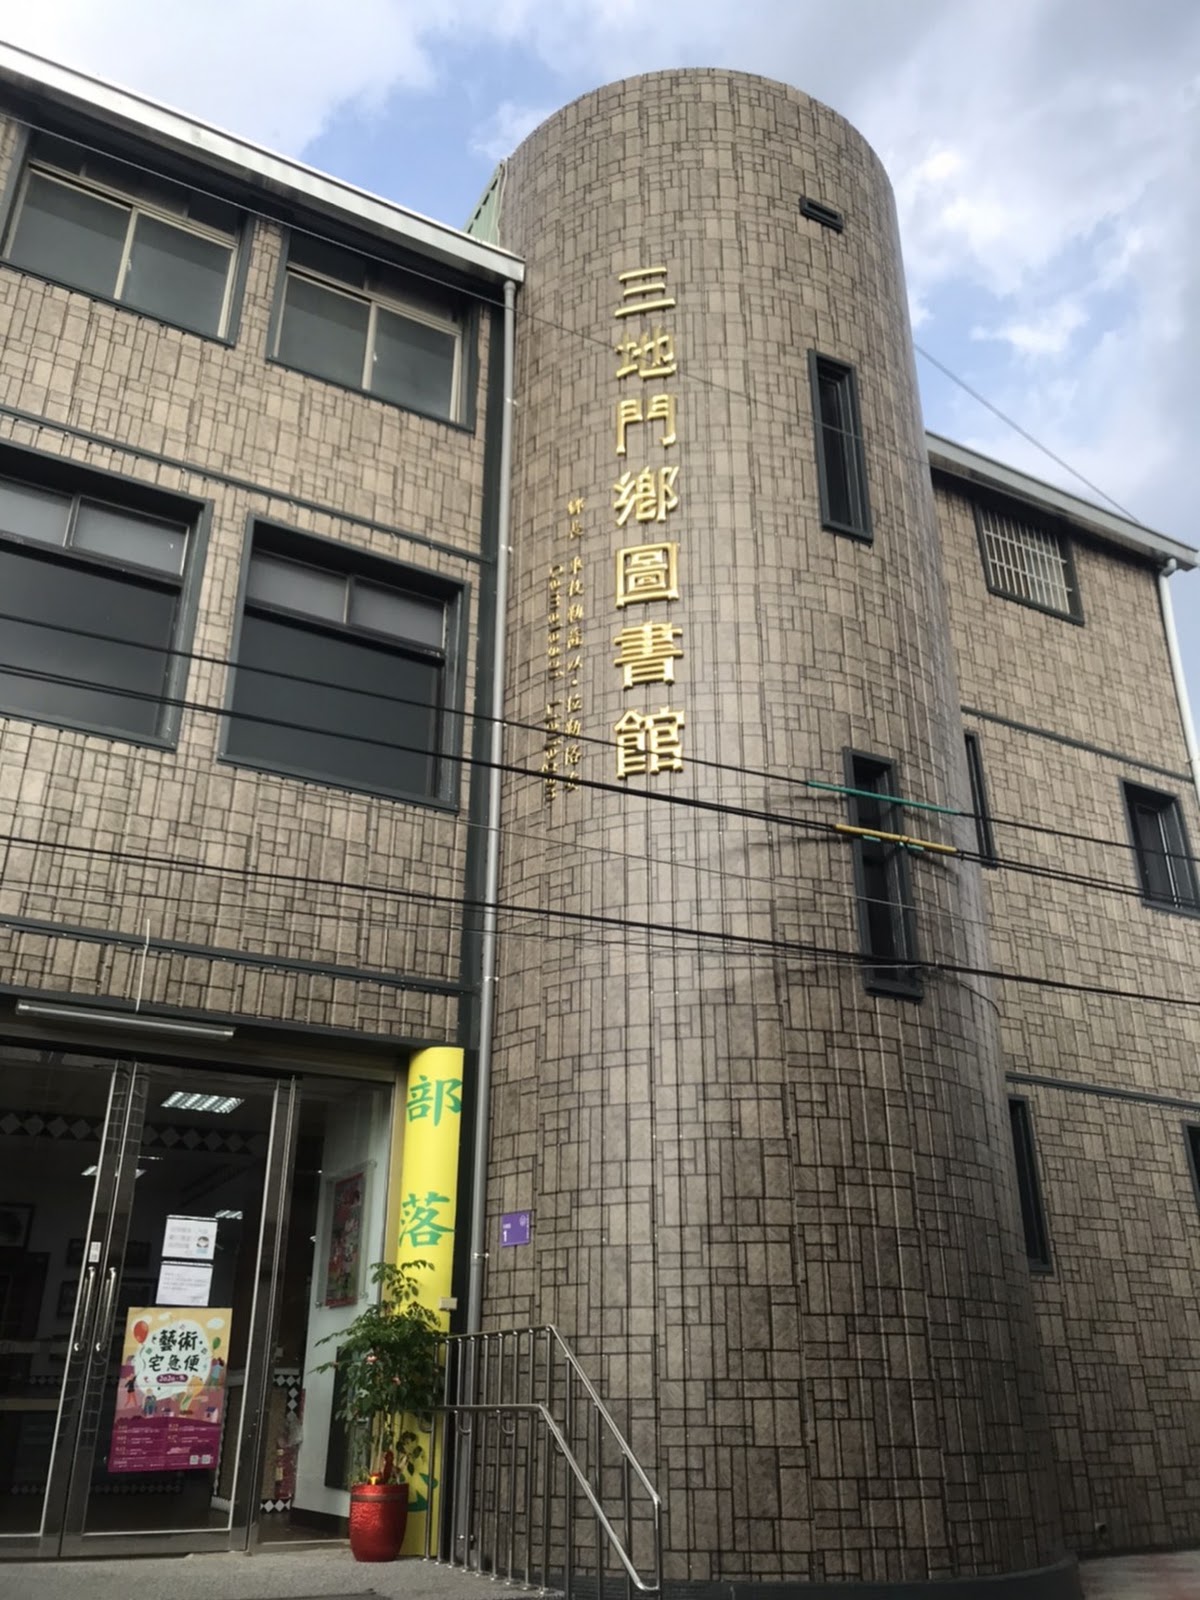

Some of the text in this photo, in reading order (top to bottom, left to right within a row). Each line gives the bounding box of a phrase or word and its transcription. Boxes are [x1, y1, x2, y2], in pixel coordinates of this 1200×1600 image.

[613, 266, 686, 780] 三地門鄉圖書館
[159, 1329, 198, 1352] 藝術
[149, 1354, 200, 1372] 宅急便
